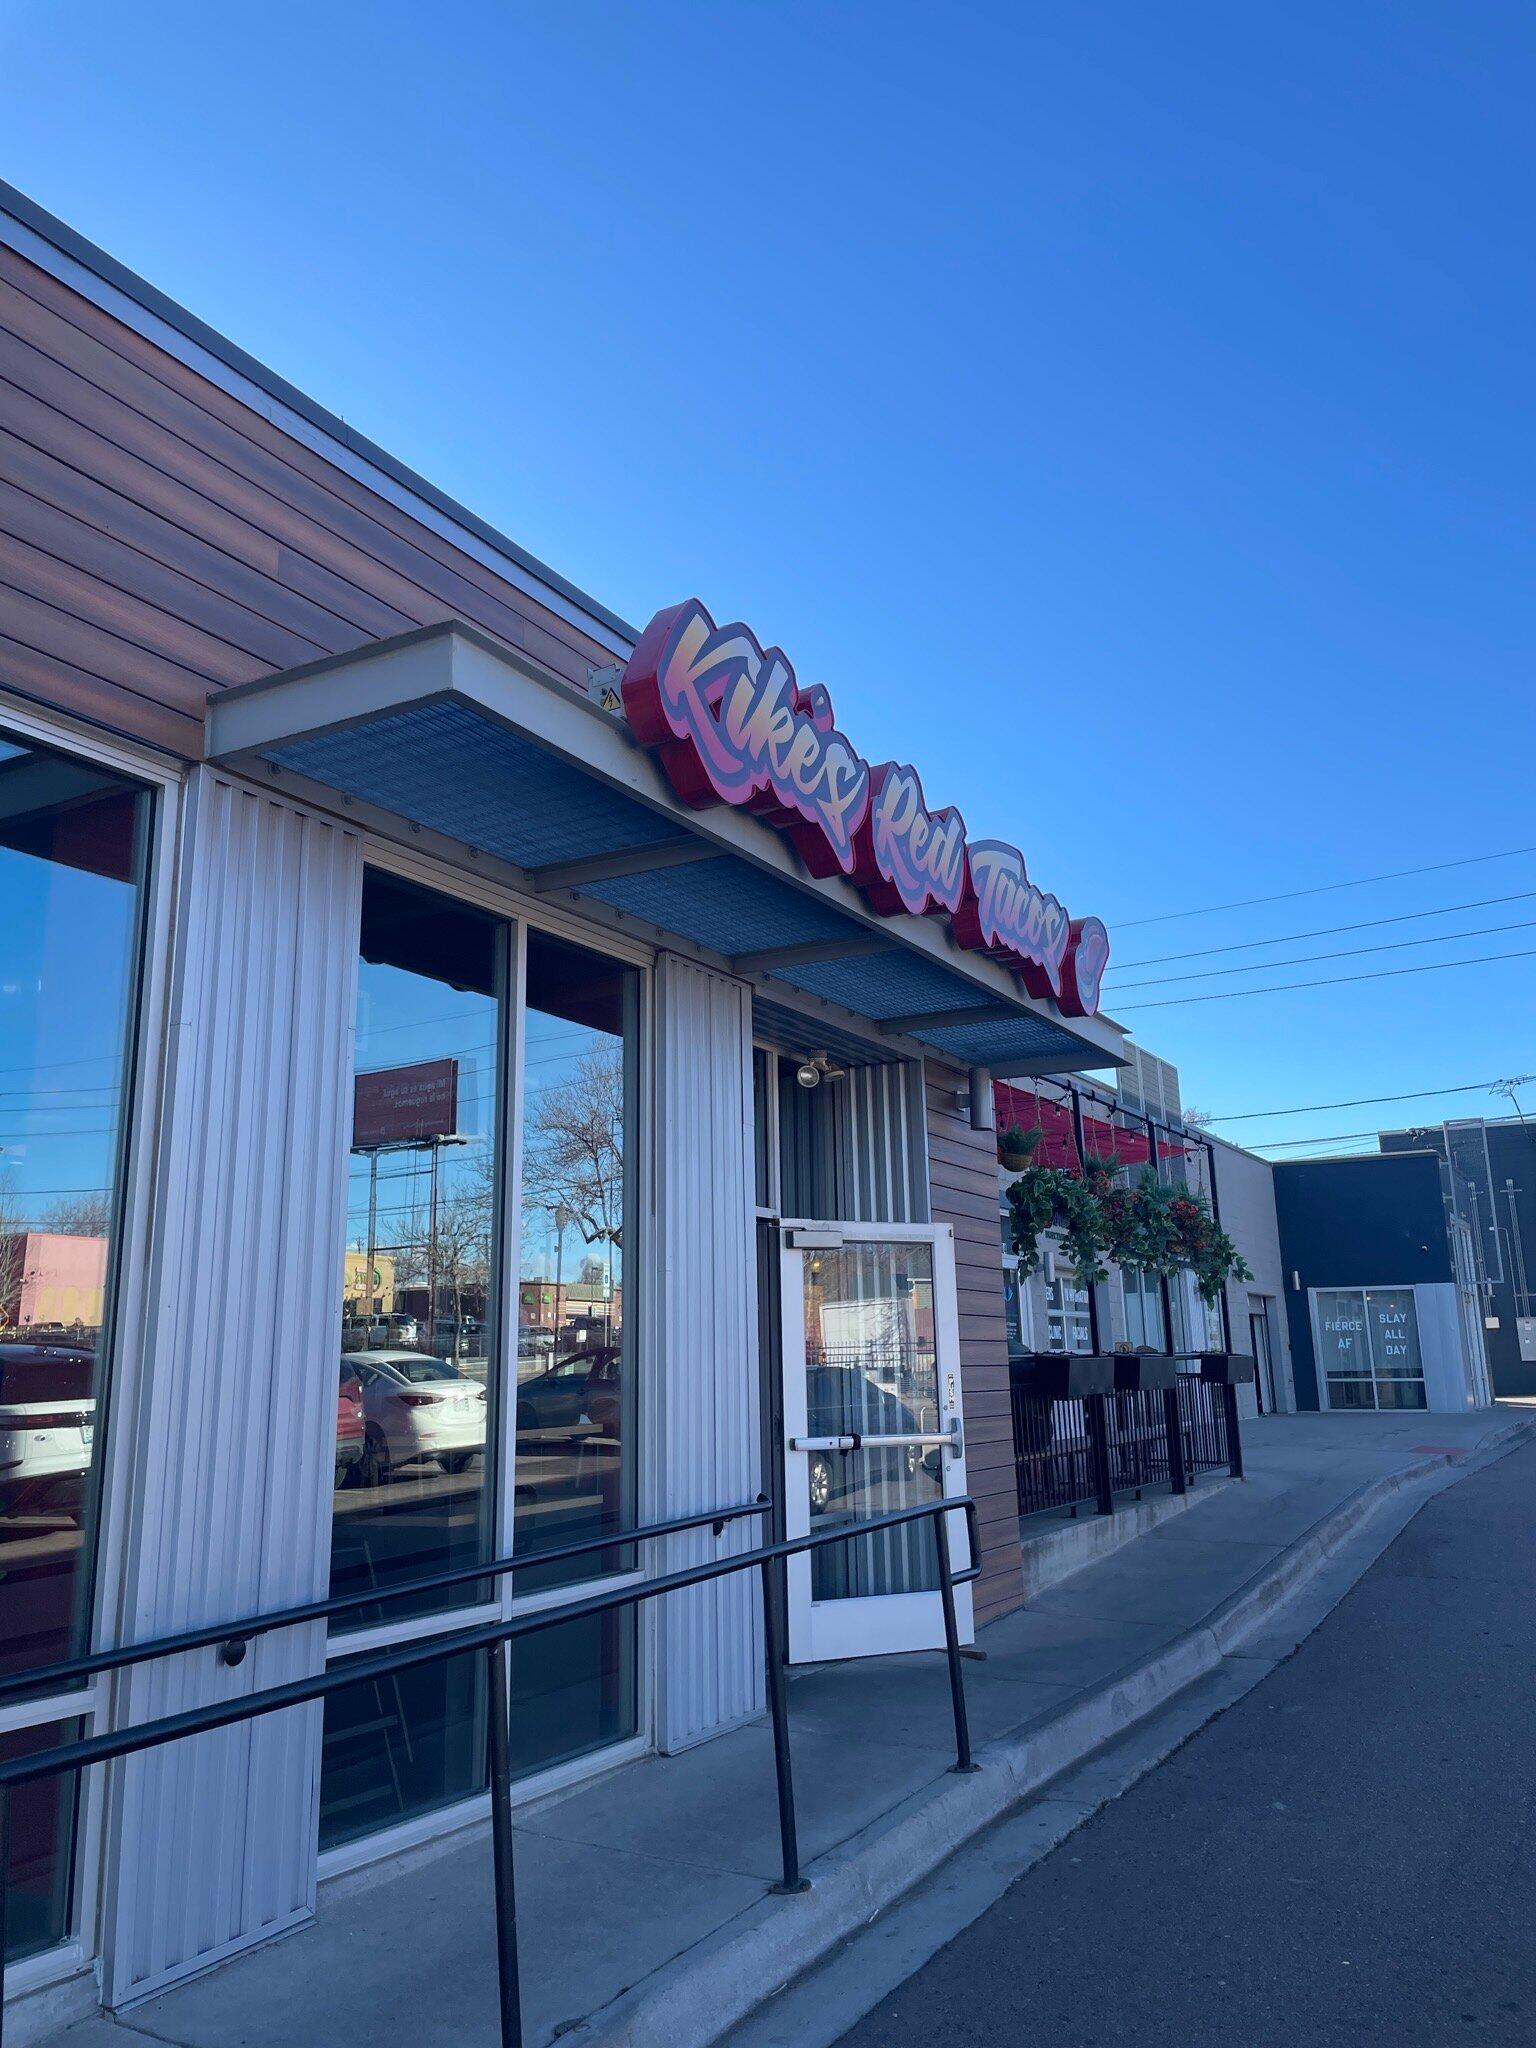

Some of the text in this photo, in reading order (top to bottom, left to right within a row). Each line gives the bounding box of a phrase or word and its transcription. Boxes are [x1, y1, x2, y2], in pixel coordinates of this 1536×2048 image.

[875, 772, 964, 891] Red
[971, 849, 1067, 984] Tacos
[1379, 1313, 1407, 1324] SLAY
[1325, 1321, 1363, 1332] FIERCE
[1384, 1329, 1406, 1339] ALL
[1338, 1338, 1353, 1349] AF
[1386, 1344, 1407, 1355] DAY
